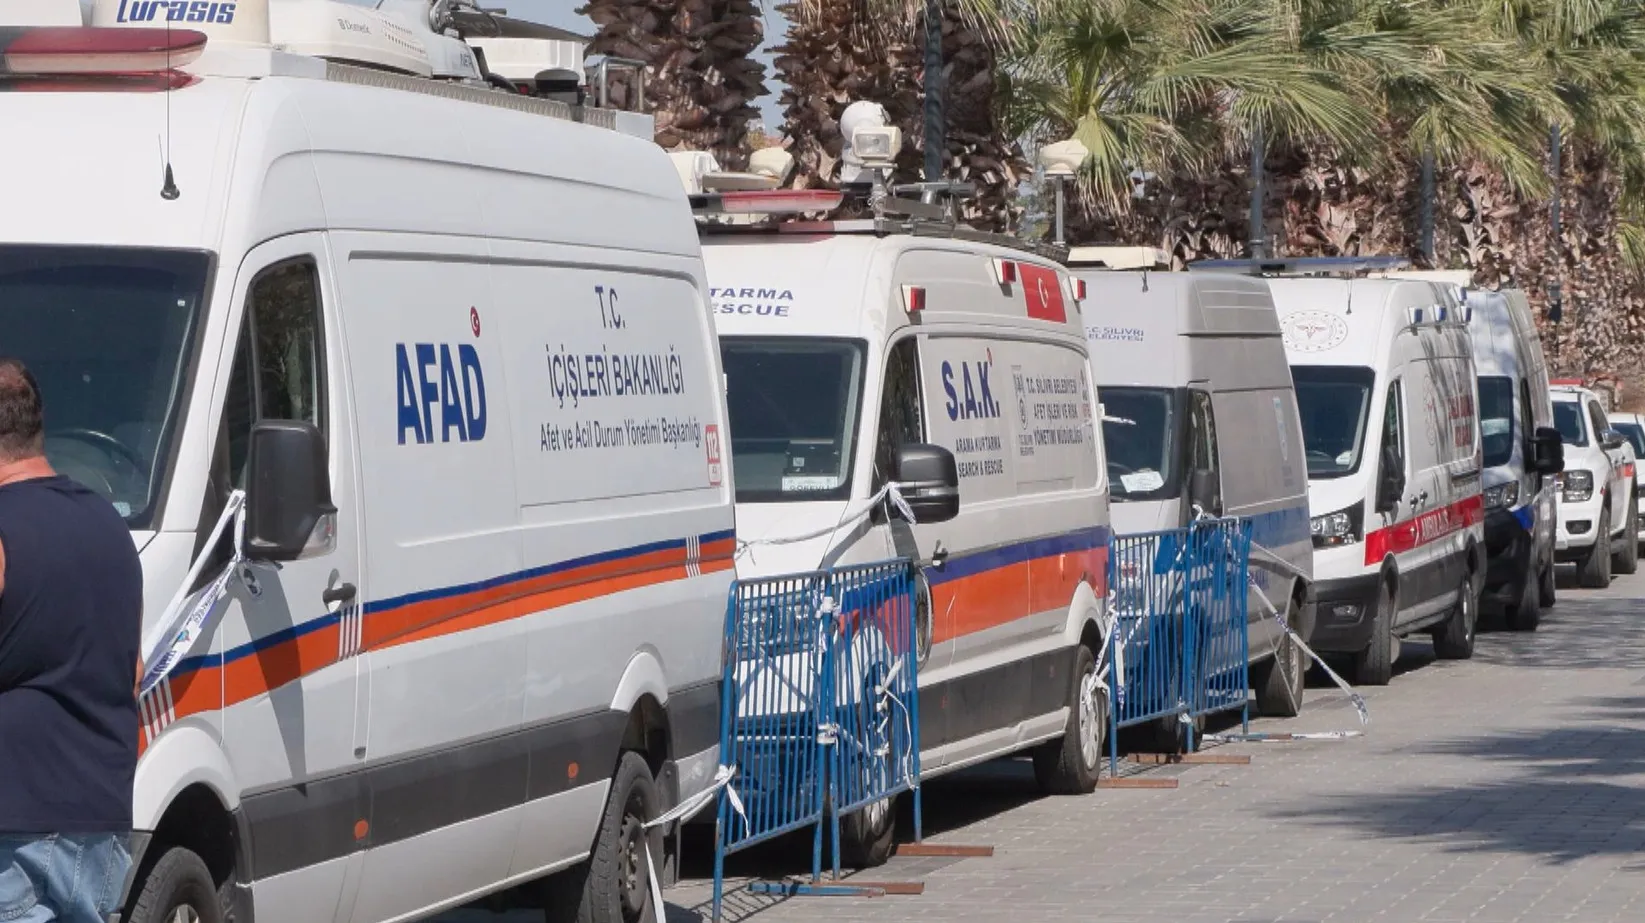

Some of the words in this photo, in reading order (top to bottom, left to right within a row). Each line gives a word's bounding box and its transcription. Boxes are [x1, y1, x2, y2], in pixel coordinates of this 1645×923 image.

[594, 285, 626, 329] T.C.
[709, 287, 794, 300] TARMA
[396, 343, 488, 445] AFAD
[545, 343, 611, 409] İÇİŞLERİ
[612, 344, 685, 397] BAKANLIĞI
[941, 360, 1001, 421] S.A.K.
[541, 423, 561, 452] Afet
[562, 427, 574, 450] ve
[575, 421, 593, 449] Acil
[594, 419, 624, 448] Durum
[624, 416, 661, 447] Yönetimi
[661, 415, 702, 450] Başkanlığı
[707, 430, 720, 460] 112
[958, 460, 979, 478] SEARCH
[984, 458, 1004, 476] RESCUE
